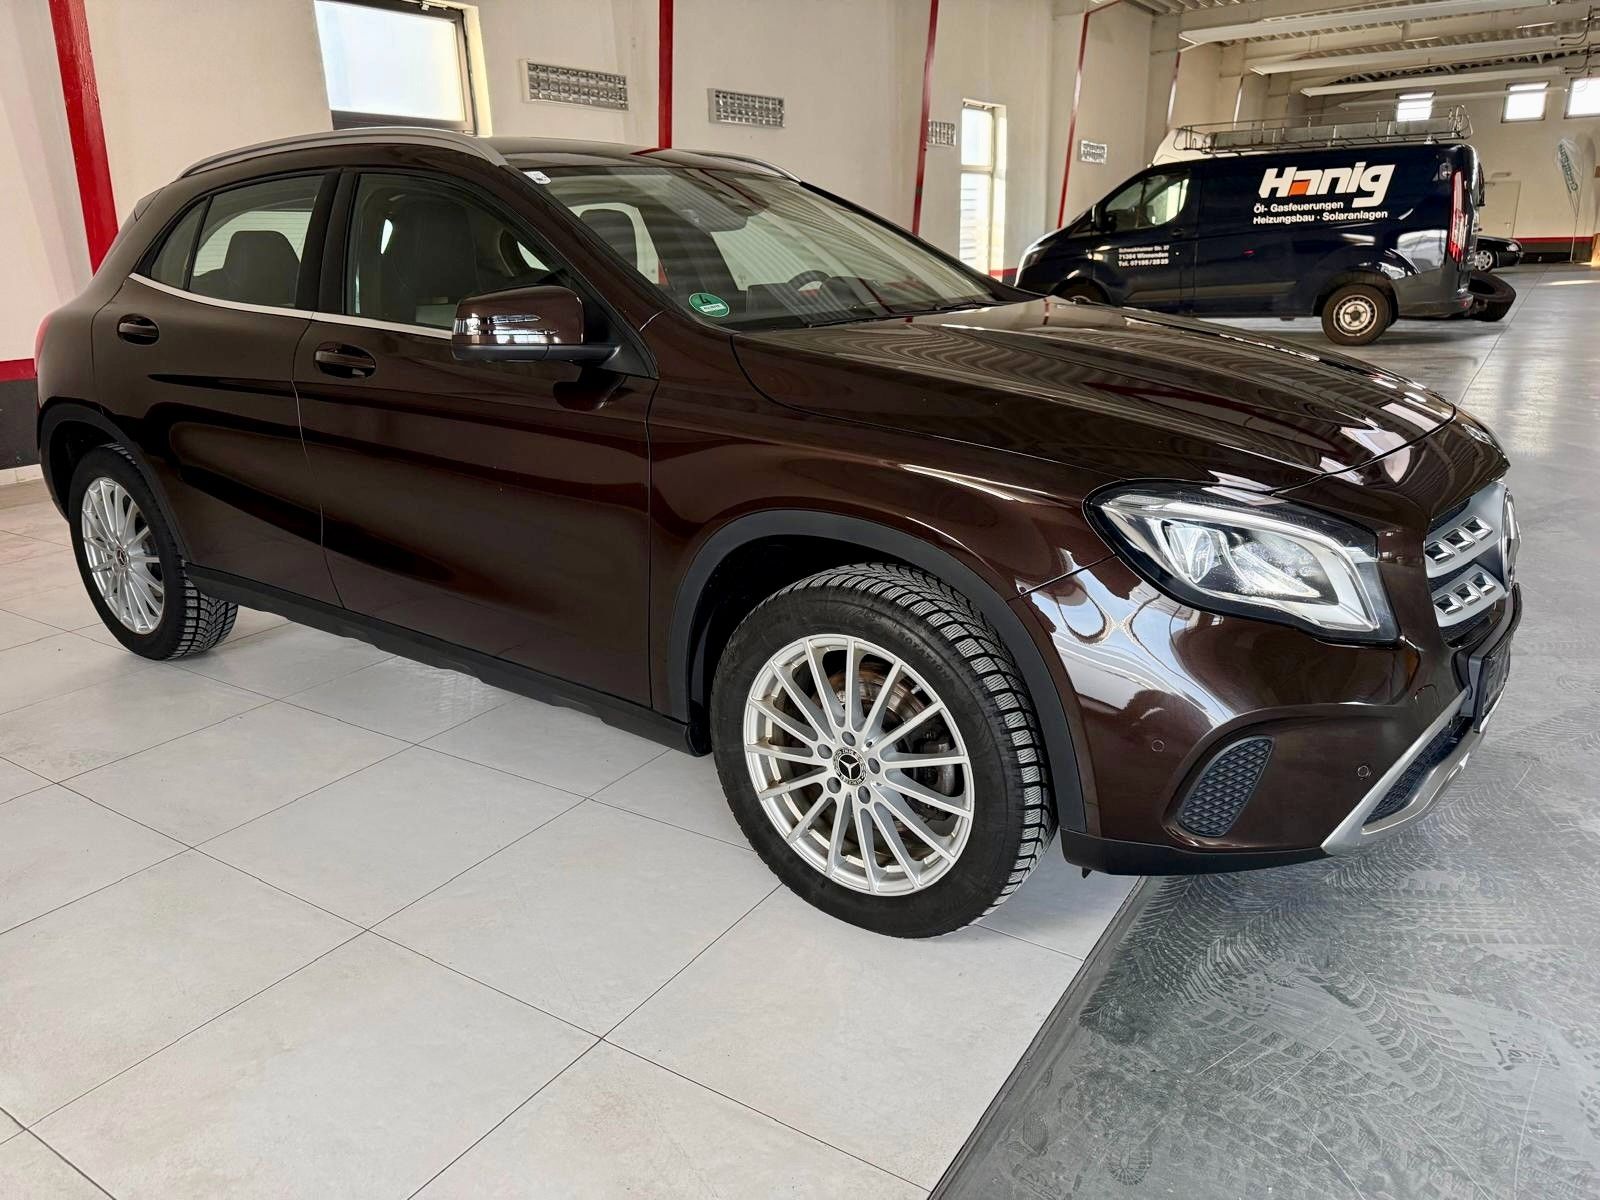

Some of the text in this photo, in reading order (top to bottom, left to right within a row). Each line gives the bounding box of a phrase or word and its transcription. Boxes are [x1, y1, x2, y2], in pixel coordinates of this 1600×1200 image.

[1253, 201, 1344, 213] Öl- Gasfeuerungen
[1253, 210, 1388, 225] Heizungsbau Solaranlagen
